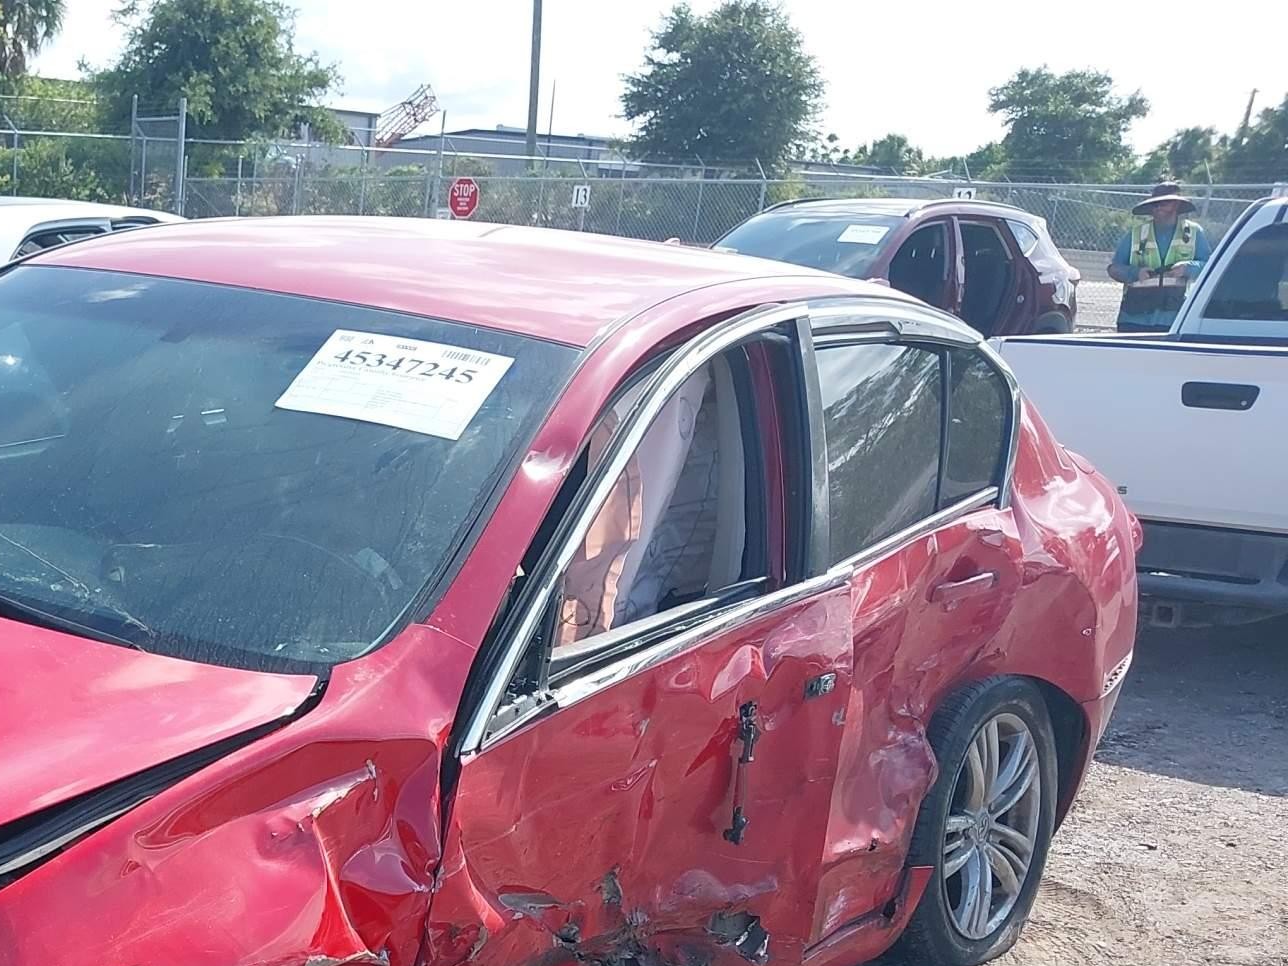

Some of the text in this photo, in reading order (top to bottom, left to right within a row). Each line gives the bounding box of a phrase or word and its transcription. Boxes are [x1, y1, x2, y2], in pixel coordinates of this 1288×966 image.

[453, 183, 475, 197] STOP
[575, 187, 588, 206] 13
[334, 349, 478, 384] 45347245
